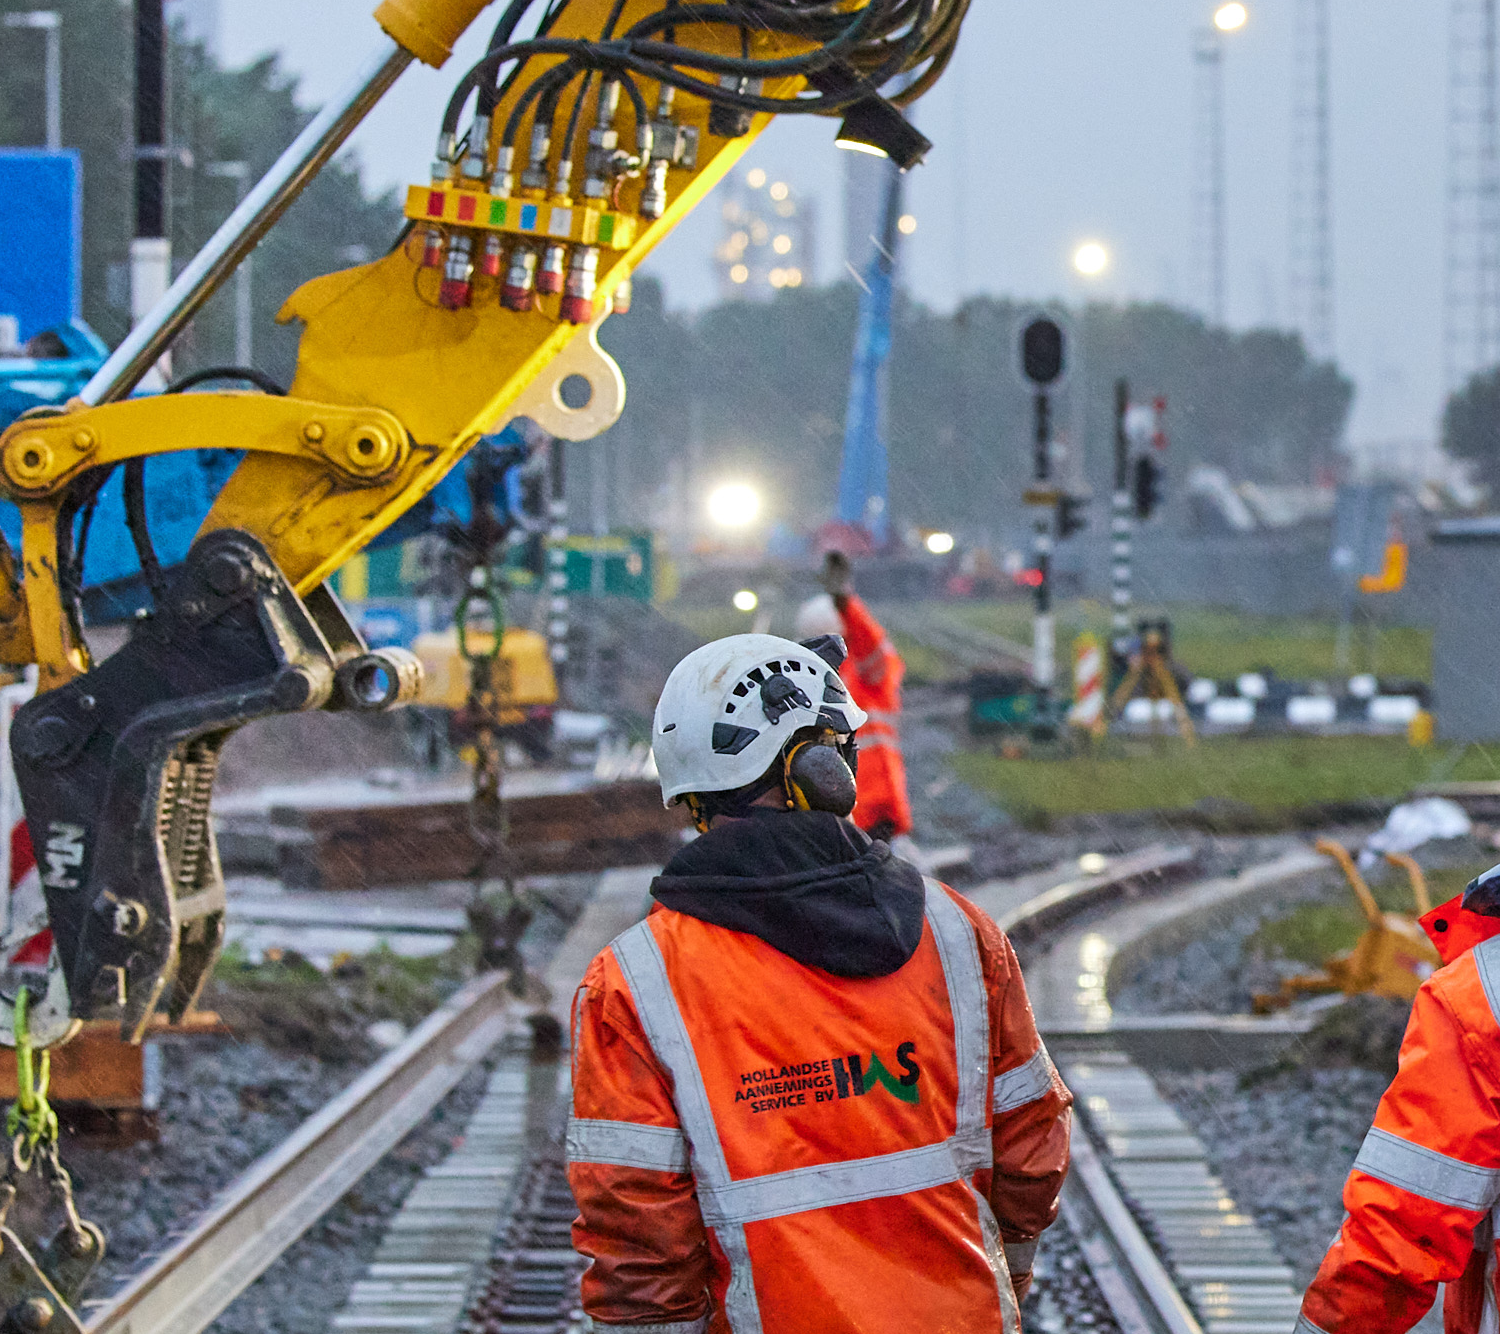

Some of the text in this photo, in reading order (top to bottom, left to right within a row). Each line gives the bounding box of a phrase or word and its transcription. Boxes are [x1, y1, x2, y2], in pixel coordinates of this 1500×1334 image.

[740, 1059, 831, 1086] HOLLANDSE
[734, 1074, 833, 1103] AANNEMINGS
[750, 1089, 835, 1114] SERVICE BV
